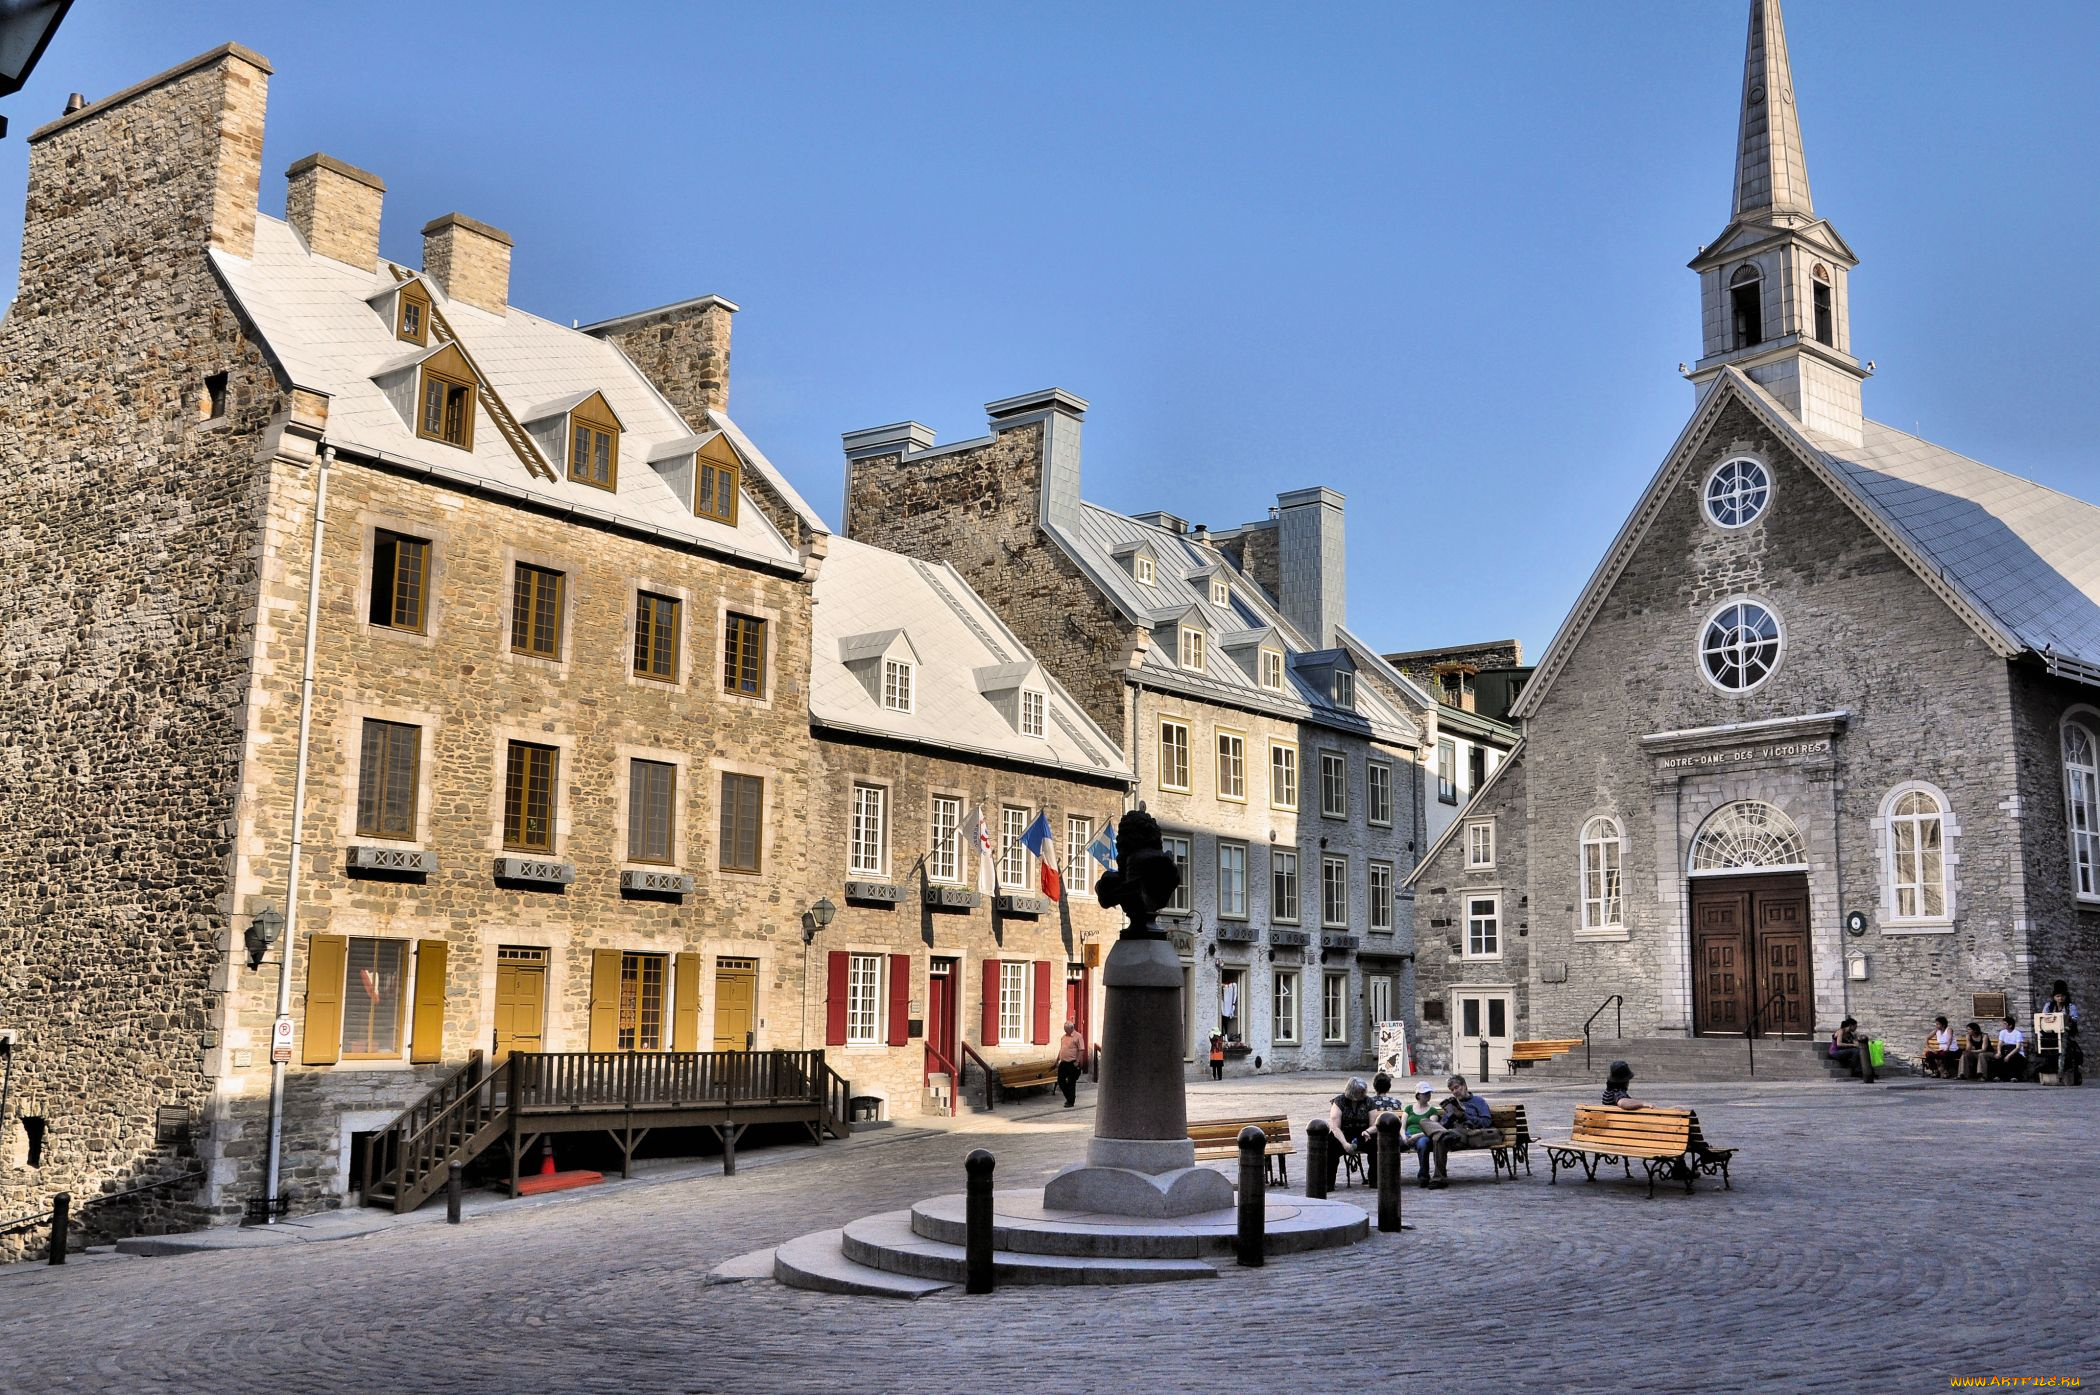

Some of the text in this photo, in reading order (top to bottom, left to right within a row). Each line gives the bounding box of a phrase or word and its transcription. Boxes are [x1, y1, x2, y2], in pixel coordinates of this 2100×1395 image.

[1664, 743, 1822, 768] NOTRE-DAME DES VICTOIRES
